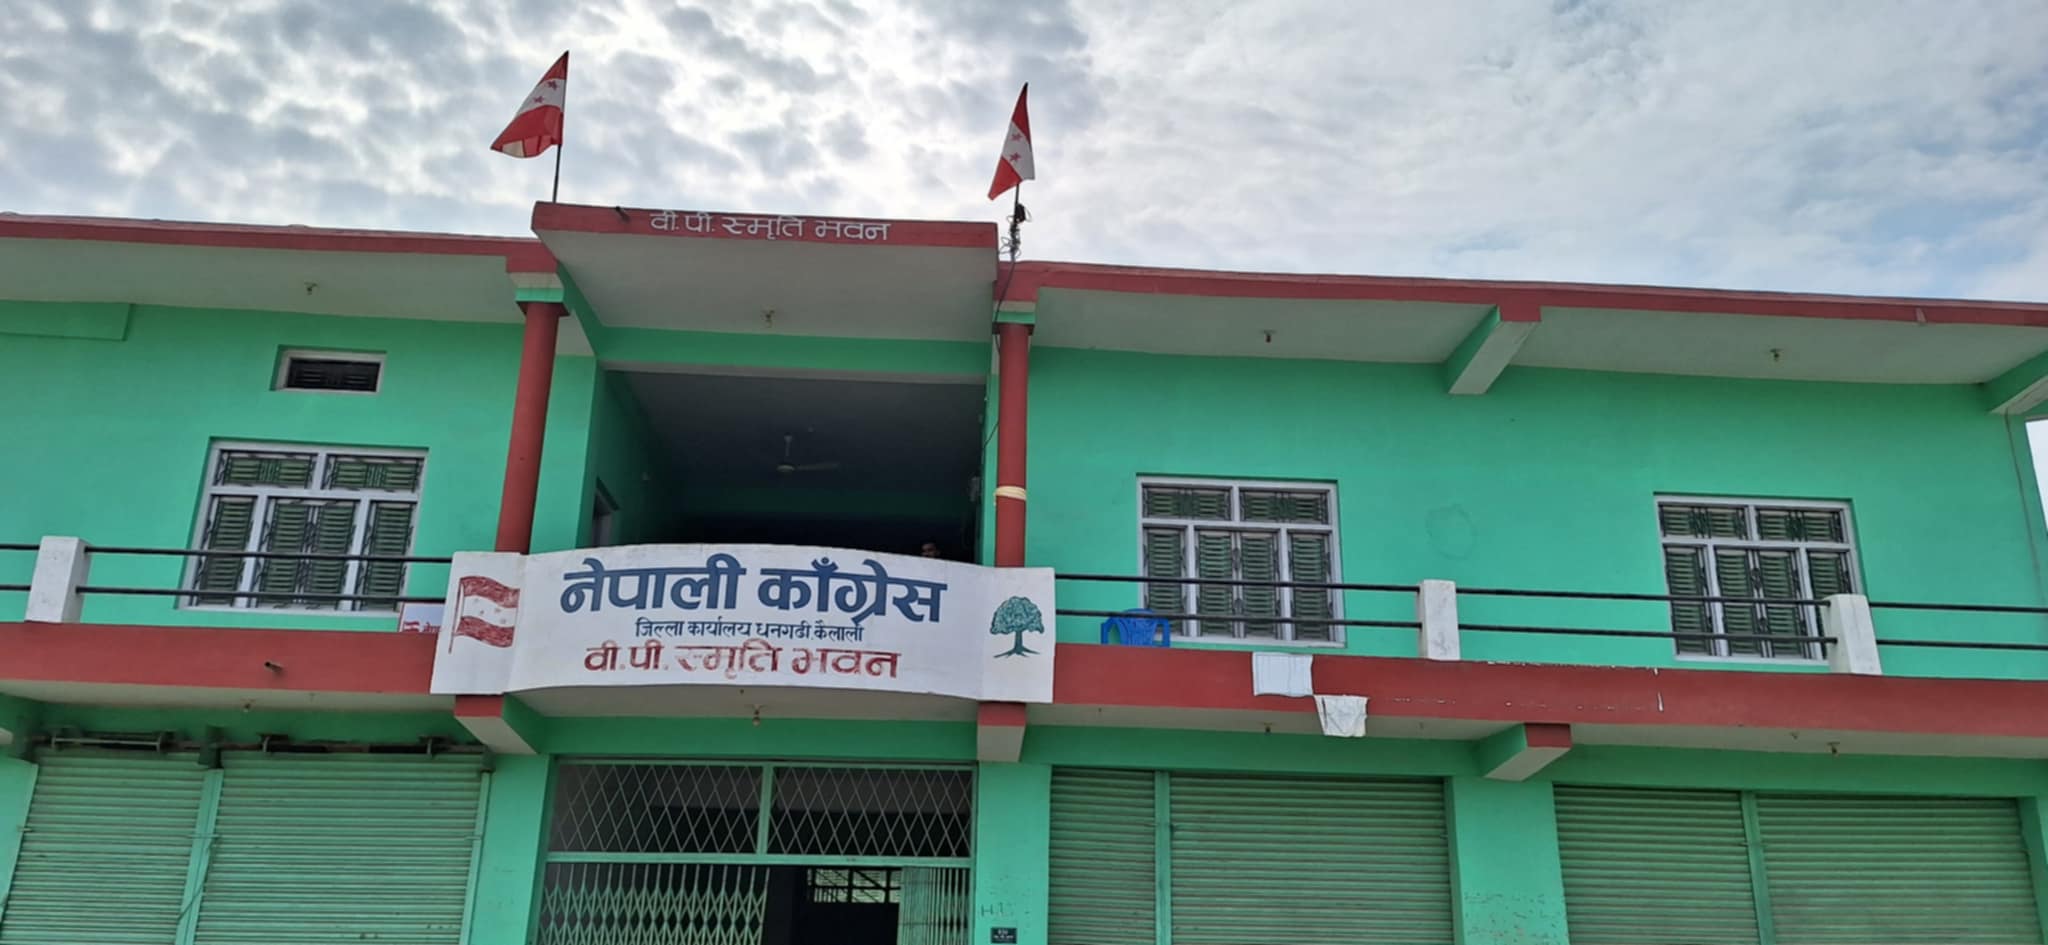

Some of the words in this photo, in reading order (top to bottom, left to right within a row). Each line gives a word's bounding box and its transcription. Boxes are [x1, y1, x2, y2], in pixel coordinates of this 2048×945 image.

[721, 215, 806, 240] स्मृति
[814, 219, 891, 241] भवन
[560, 553, 746, 614] नेपाली
[757, 557, 948, 623] काँग्रेस
[635, 616, 684, 638] जिल्ला
[687, 616, 751, 638] कार्यालय
[674, 638, 784, 680] स्मृति
[791, 646, 902, 679] भवन
